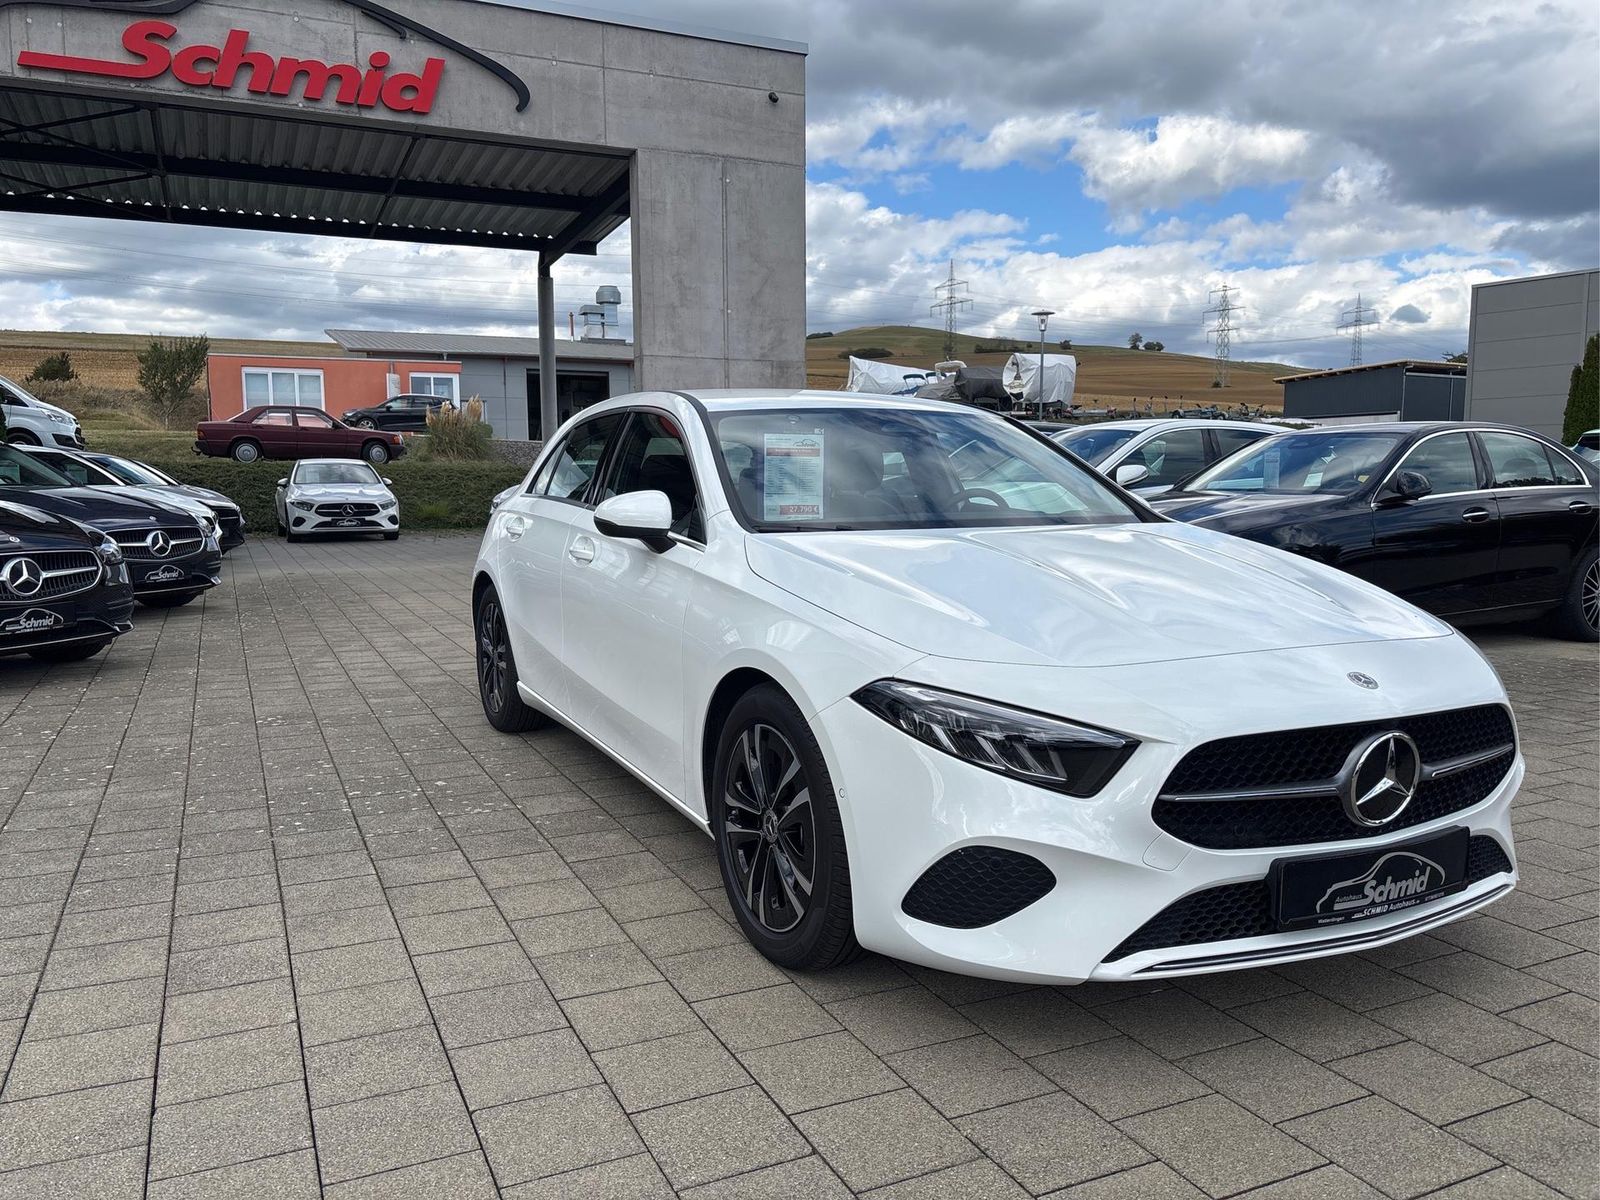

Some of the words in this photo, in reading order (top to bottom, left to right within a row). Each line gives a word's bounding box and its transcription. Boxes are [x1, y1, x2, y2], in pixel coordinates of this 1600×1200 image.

[17, 19, 446, 114] Schmid
[19, 614, 55, 629] Schmid
[1335, 894, 1363, 903] Autohaus
[1340, 866, 1431, 908] Schmid
